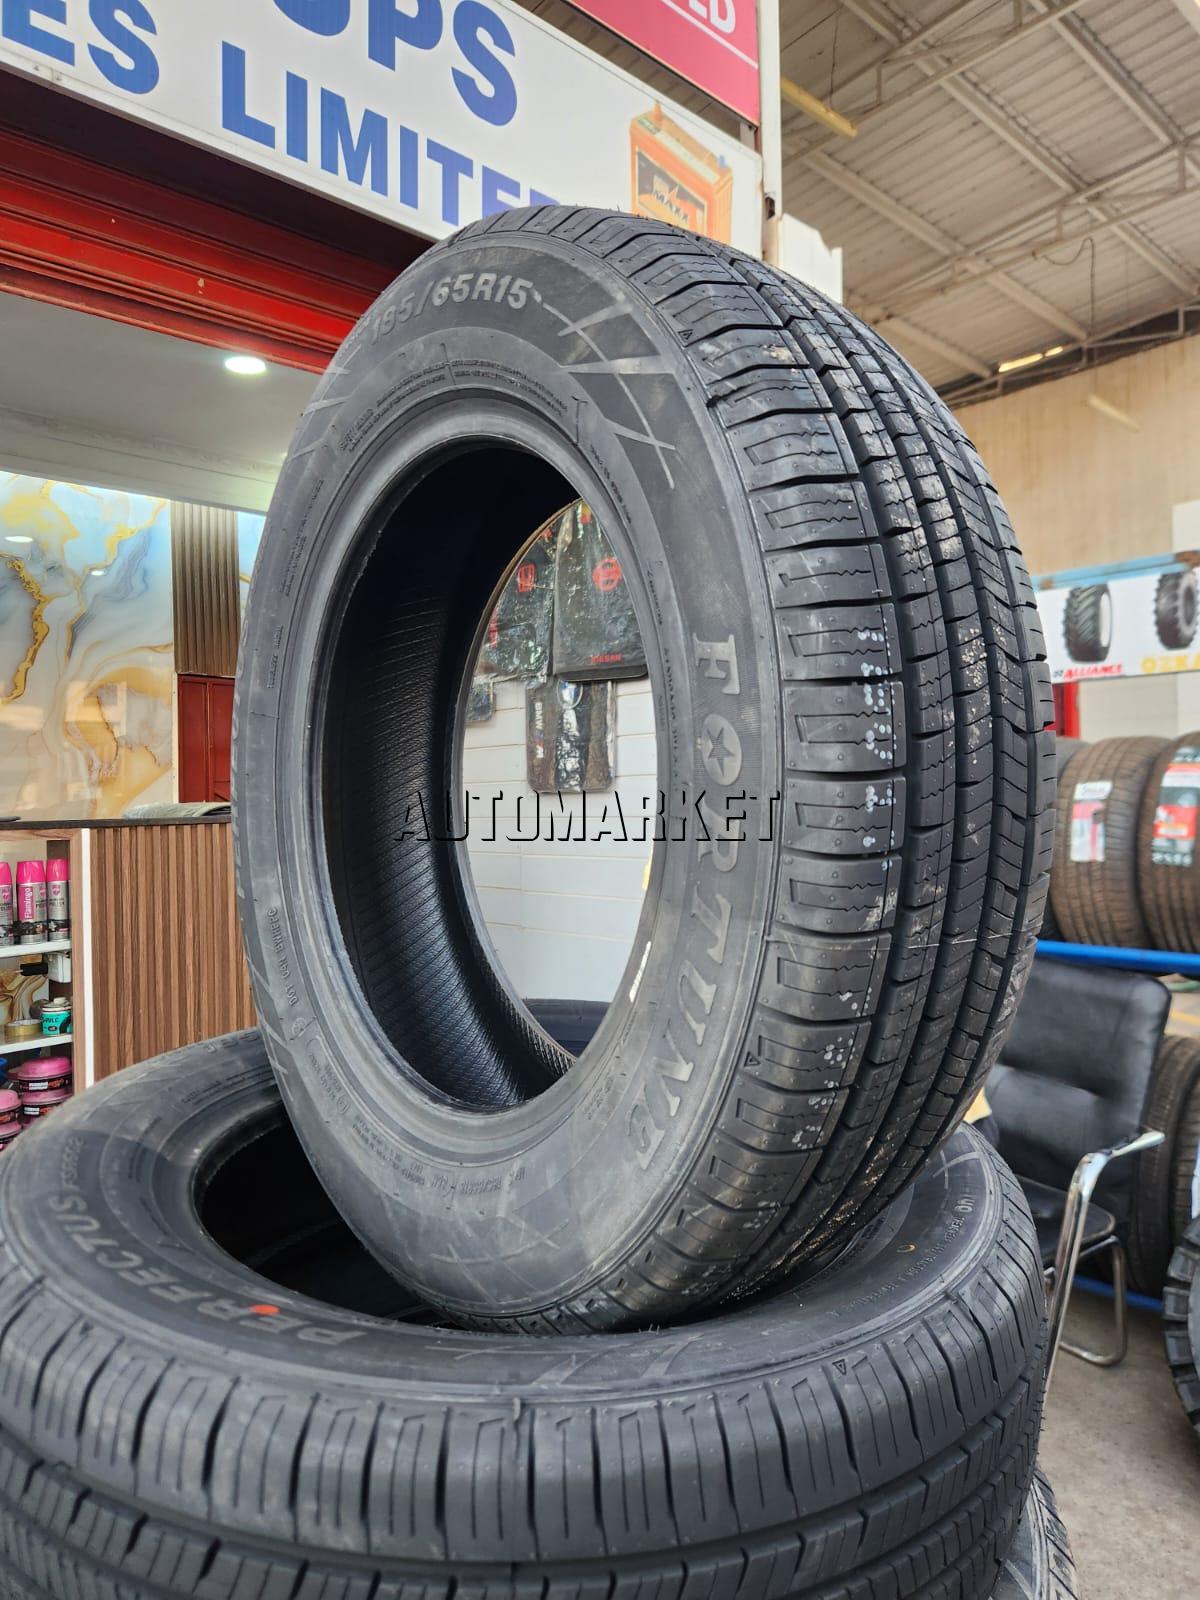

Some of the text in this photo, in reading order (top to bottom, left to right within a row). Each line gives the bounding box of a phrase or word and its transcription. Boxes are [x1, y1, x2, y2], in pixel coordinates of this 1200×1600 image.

[221, 40, 560, 227] LIMITE
[534, 701, 544, 730] BMW
[23, 888, 33, 919] Flamingo
[49, 1195, 367, 1346] PERFECTUS
